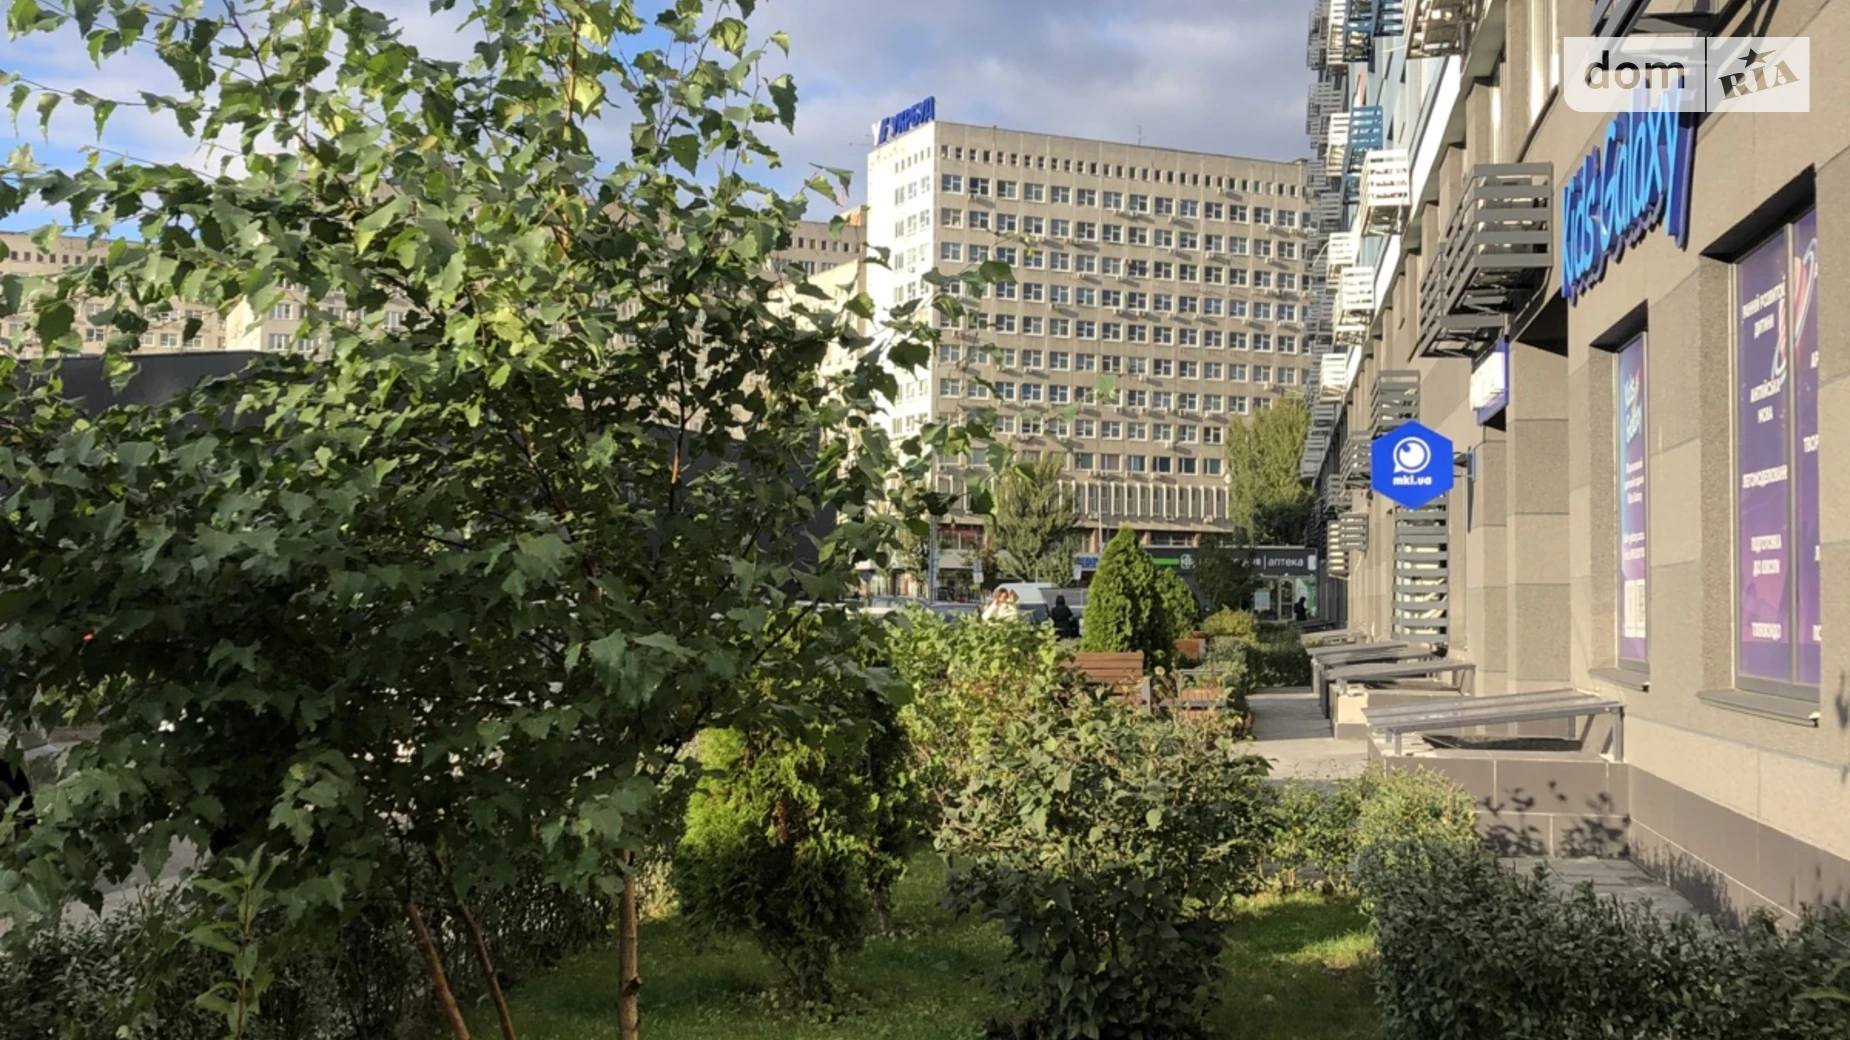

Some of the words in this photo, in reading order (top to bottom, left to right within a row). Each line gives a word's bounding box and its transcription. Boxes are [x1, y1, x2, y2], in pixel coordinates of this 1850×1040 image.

[1561, 155, 1595, 298] Kids
[1598, 86, 1689, 249] Galaxy
[1392, 474, 1433, 486] mki.ua
[1268, 556, 1304, 568] аптека
